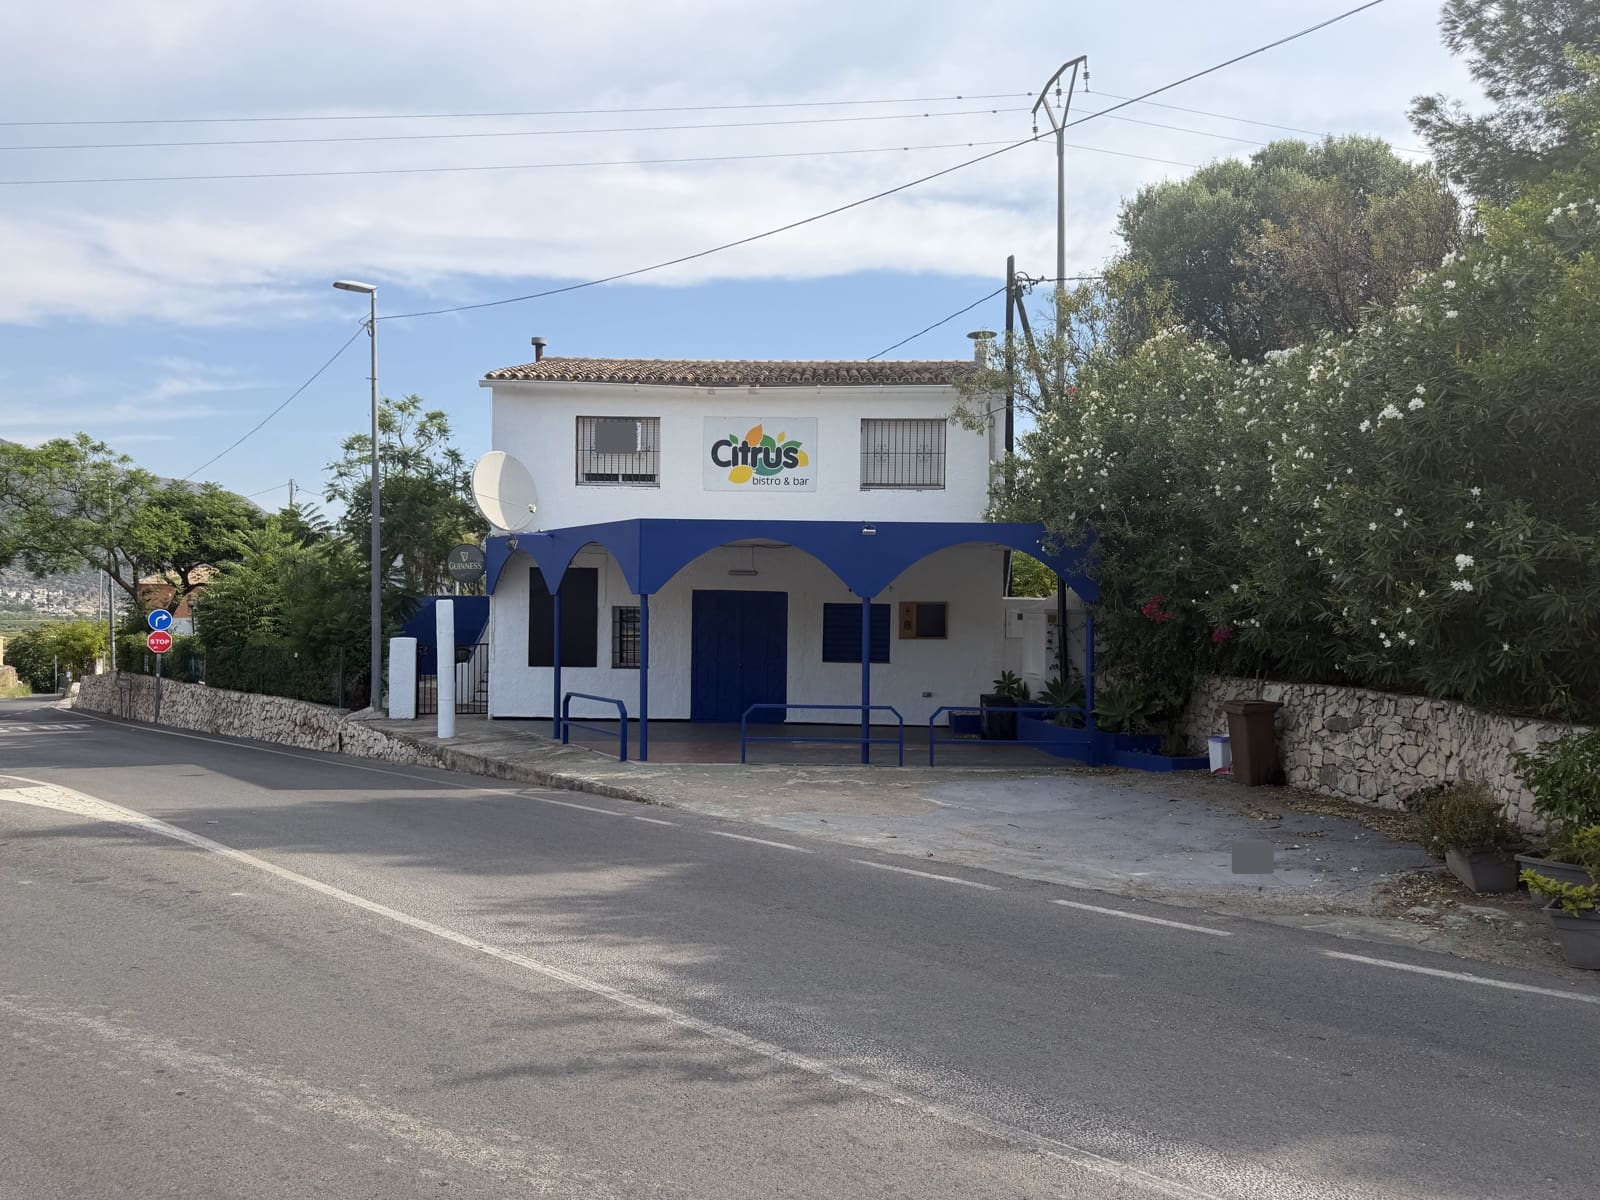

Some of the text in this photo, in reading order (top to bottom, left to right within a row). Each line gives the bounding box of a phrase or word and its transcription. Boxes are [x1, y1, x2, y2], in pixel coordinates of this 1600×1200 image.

[711, 439, 799, 469] Citrus
[752, 476, 809, 486] bistro & bar
[448, 561, 482, 570] GUINNESS
